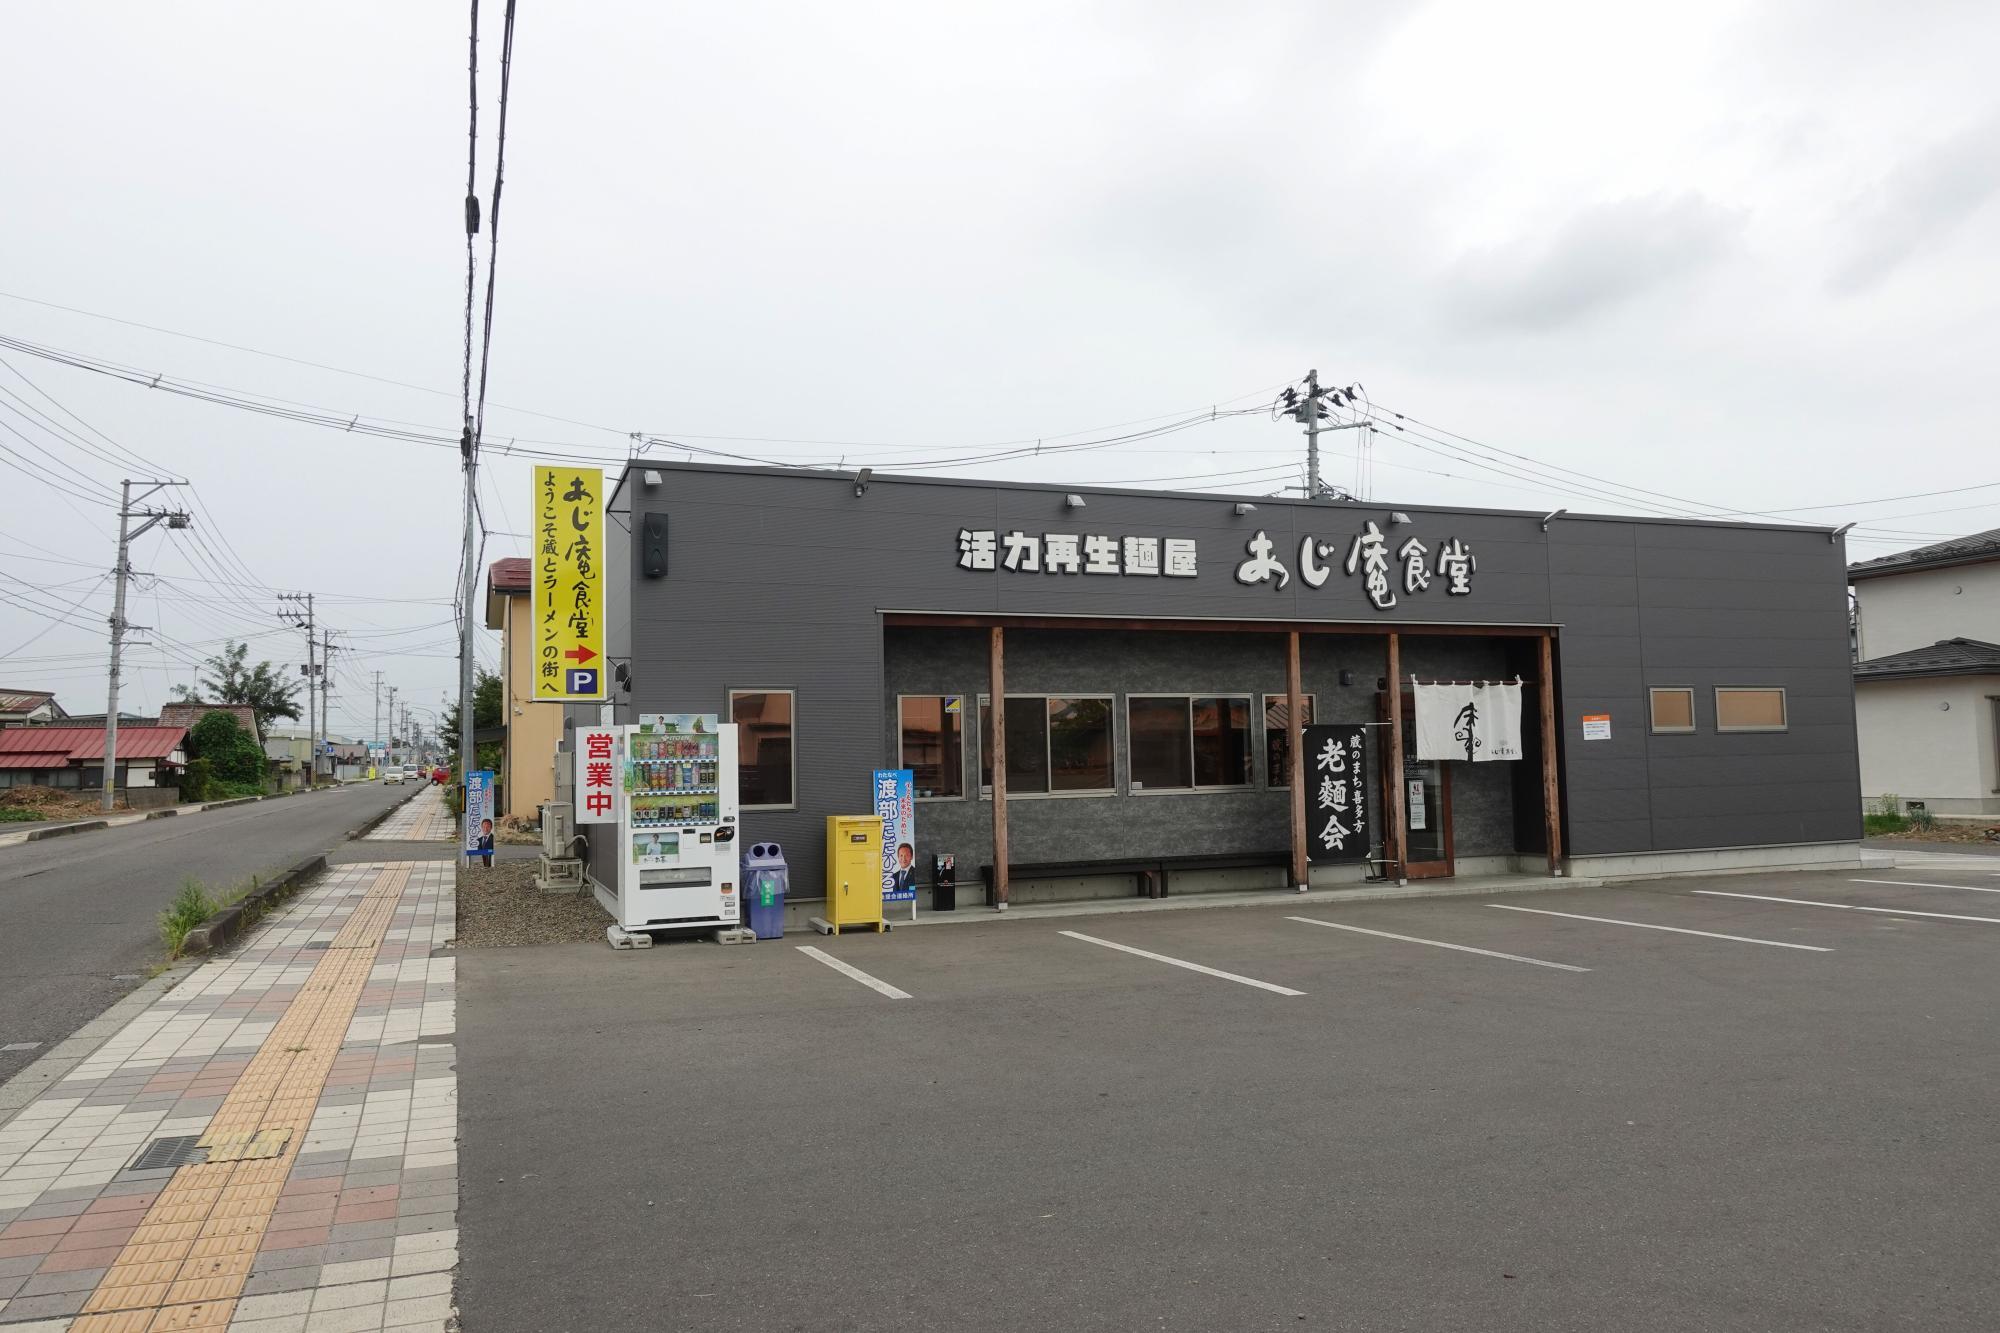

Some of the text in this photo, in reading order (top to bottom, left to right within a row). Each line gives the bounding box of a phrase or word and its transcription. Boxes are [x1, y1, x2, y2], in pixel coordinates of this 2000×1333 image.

[541, 472, 559, 693] ようこそ蔵とラーメンの街へ
[1237, 521, 1476, 608] あじ庵食堂
[573, 672, 593, 690] P
[586, 733, 613, 817] 営業中
[1349, 735, 1366, 833] 蔵のまち喜多方
